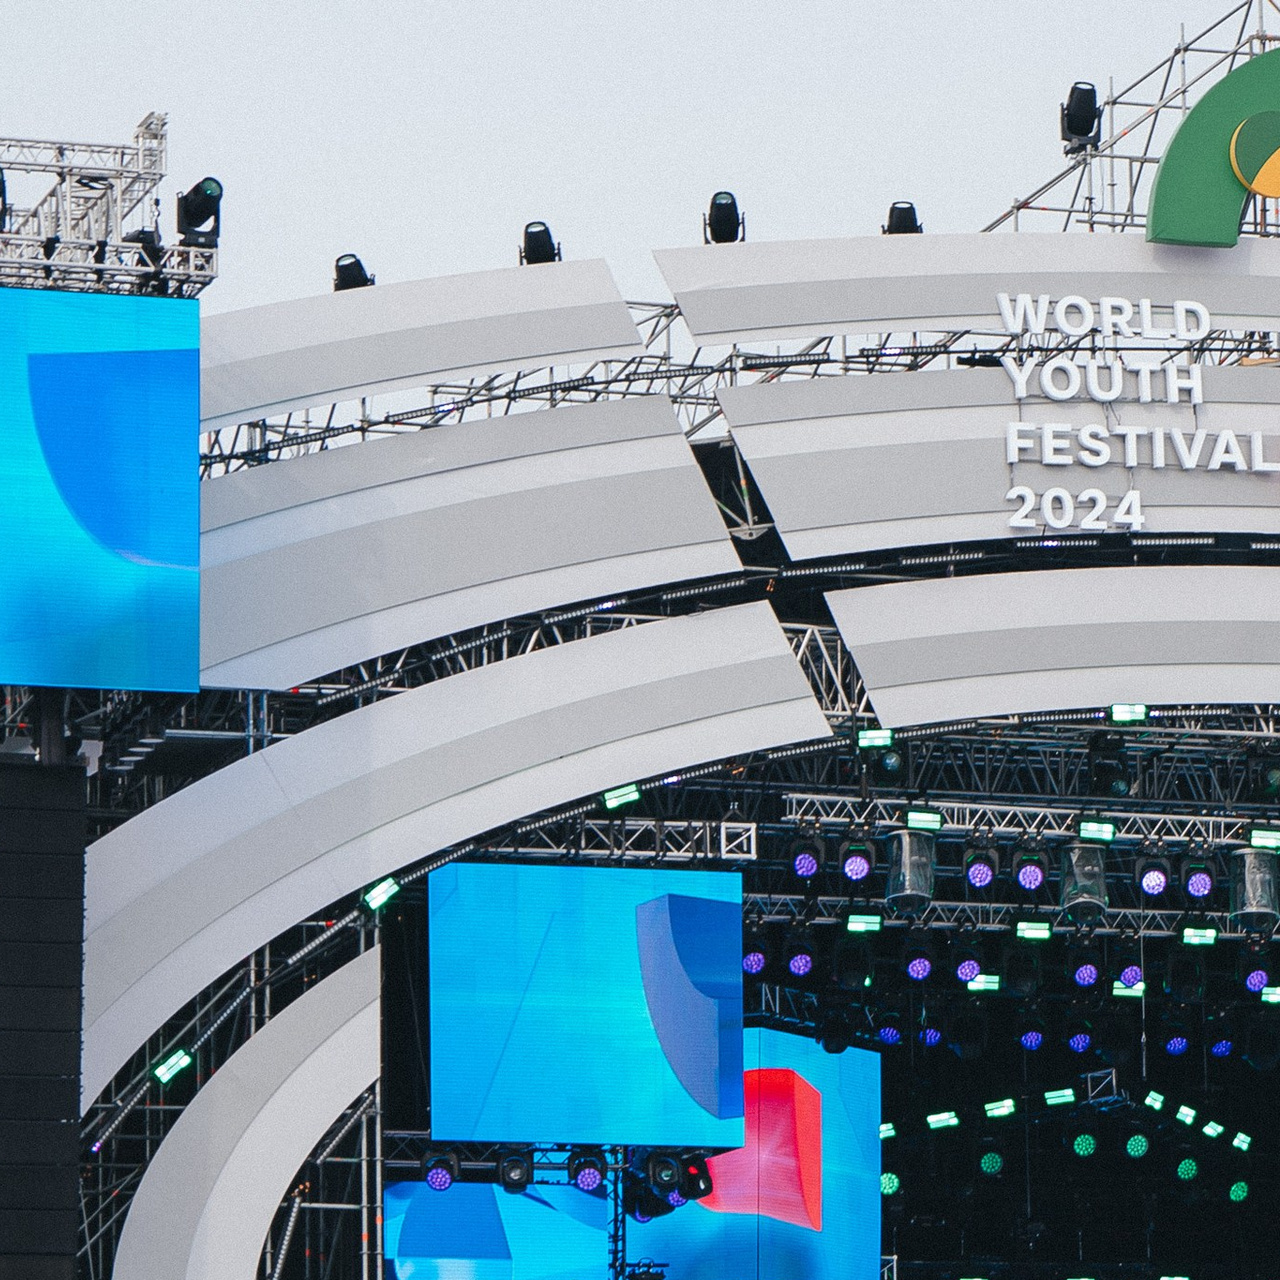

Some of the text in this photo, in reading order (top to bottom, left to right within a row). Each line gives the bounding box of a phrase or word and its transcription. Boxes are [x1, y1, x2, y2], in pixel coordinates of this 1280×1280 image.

[997, 293, 1210, 341] WORLD
[1001, 356, 1203, 404] YOUTH
[1006, 422, 1280, 472] FESTIVAL
[1005, 486, 1145, 532] 2024
